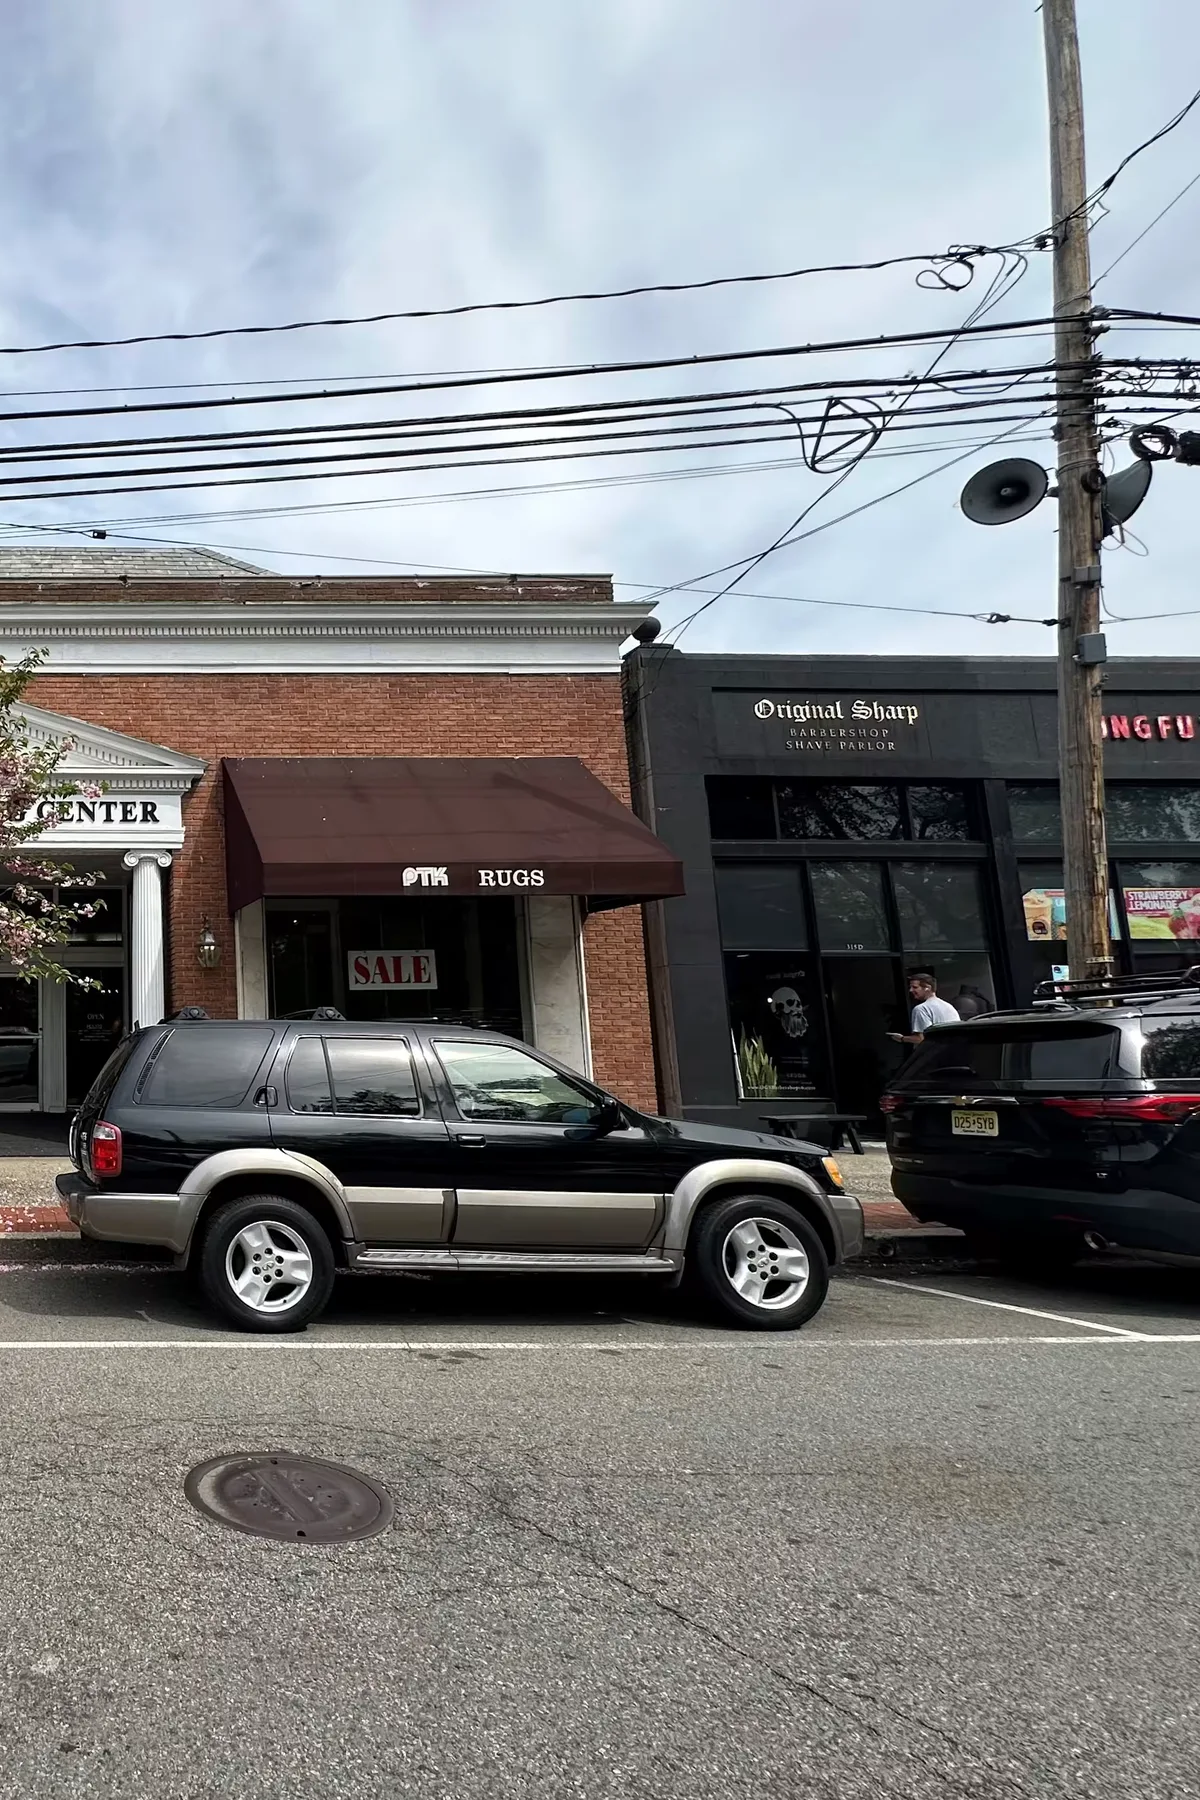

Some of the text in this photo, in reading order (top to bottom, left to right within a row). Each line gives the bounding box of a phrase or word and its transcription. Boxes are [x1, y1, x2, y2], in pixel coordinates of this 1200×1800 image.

[753, 698, 919, 725] Original Sharp
[789, 728, 889, 738] BARBERSHOP
[1157, 714, 1195, 739] FU
[785, 740, 896, 751] SHAVE PARLOR
[36, 800, 160, 823] CENTER
[402, 866, 449, 887] PTK
[478, 869, 545, 887] RUGS
[1127, 890, 1188, 901] STRAWBERRY
[1128, 900, 1178, 910] LEMONADE
[353, 955, 432, 985] SALE
